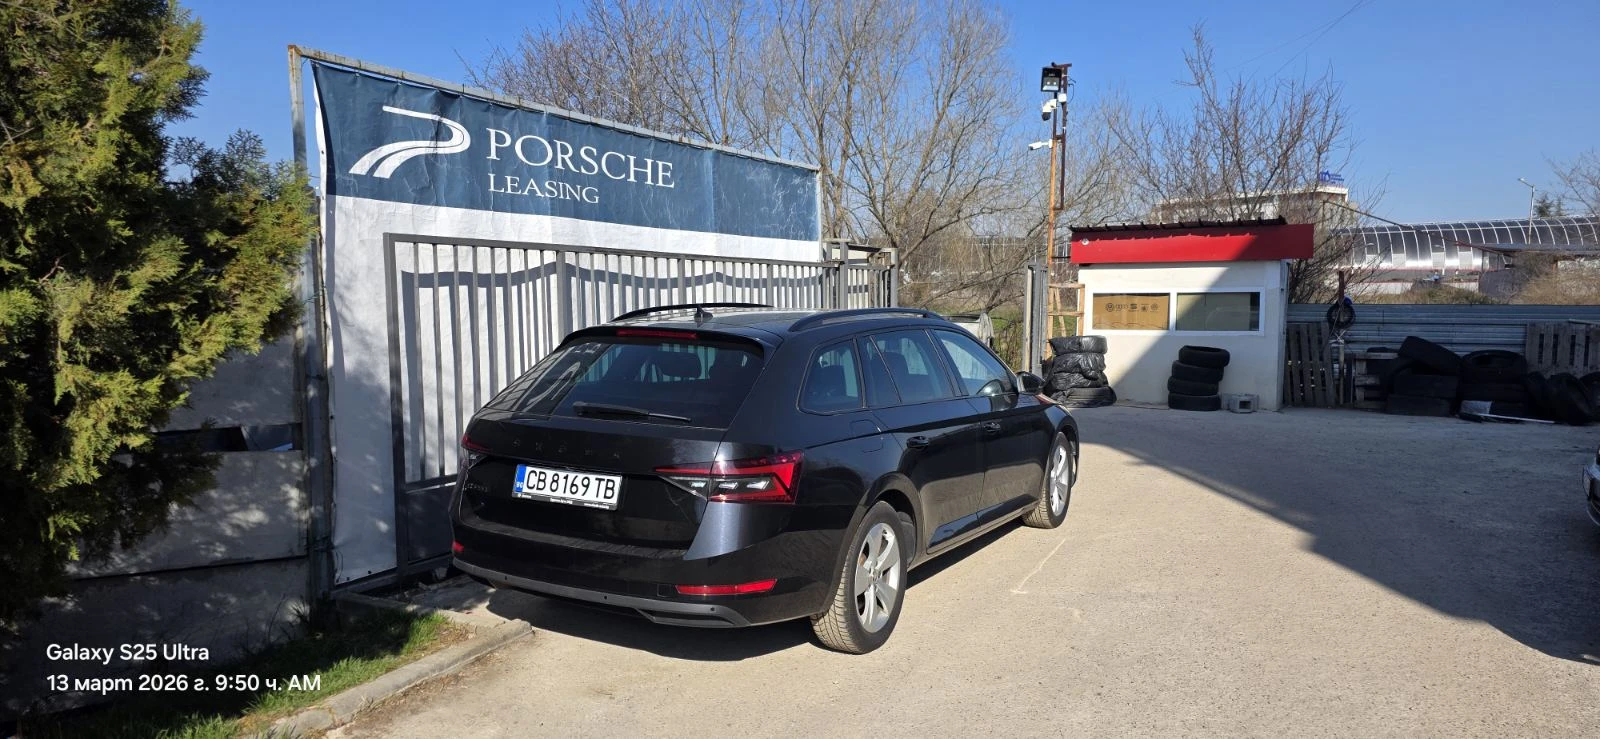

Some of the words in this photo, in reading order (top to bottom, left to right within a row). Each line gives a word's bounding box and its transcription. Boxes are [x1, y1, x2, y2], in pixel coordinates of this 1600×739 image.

[486, 127, 675, 189] PORSCHE
[488, 173, 600, 204] LEASING
[526, 469, 547, 491] CB
[549, 472, 591, 497] 8169
[595, 477, 616, 500] TB
